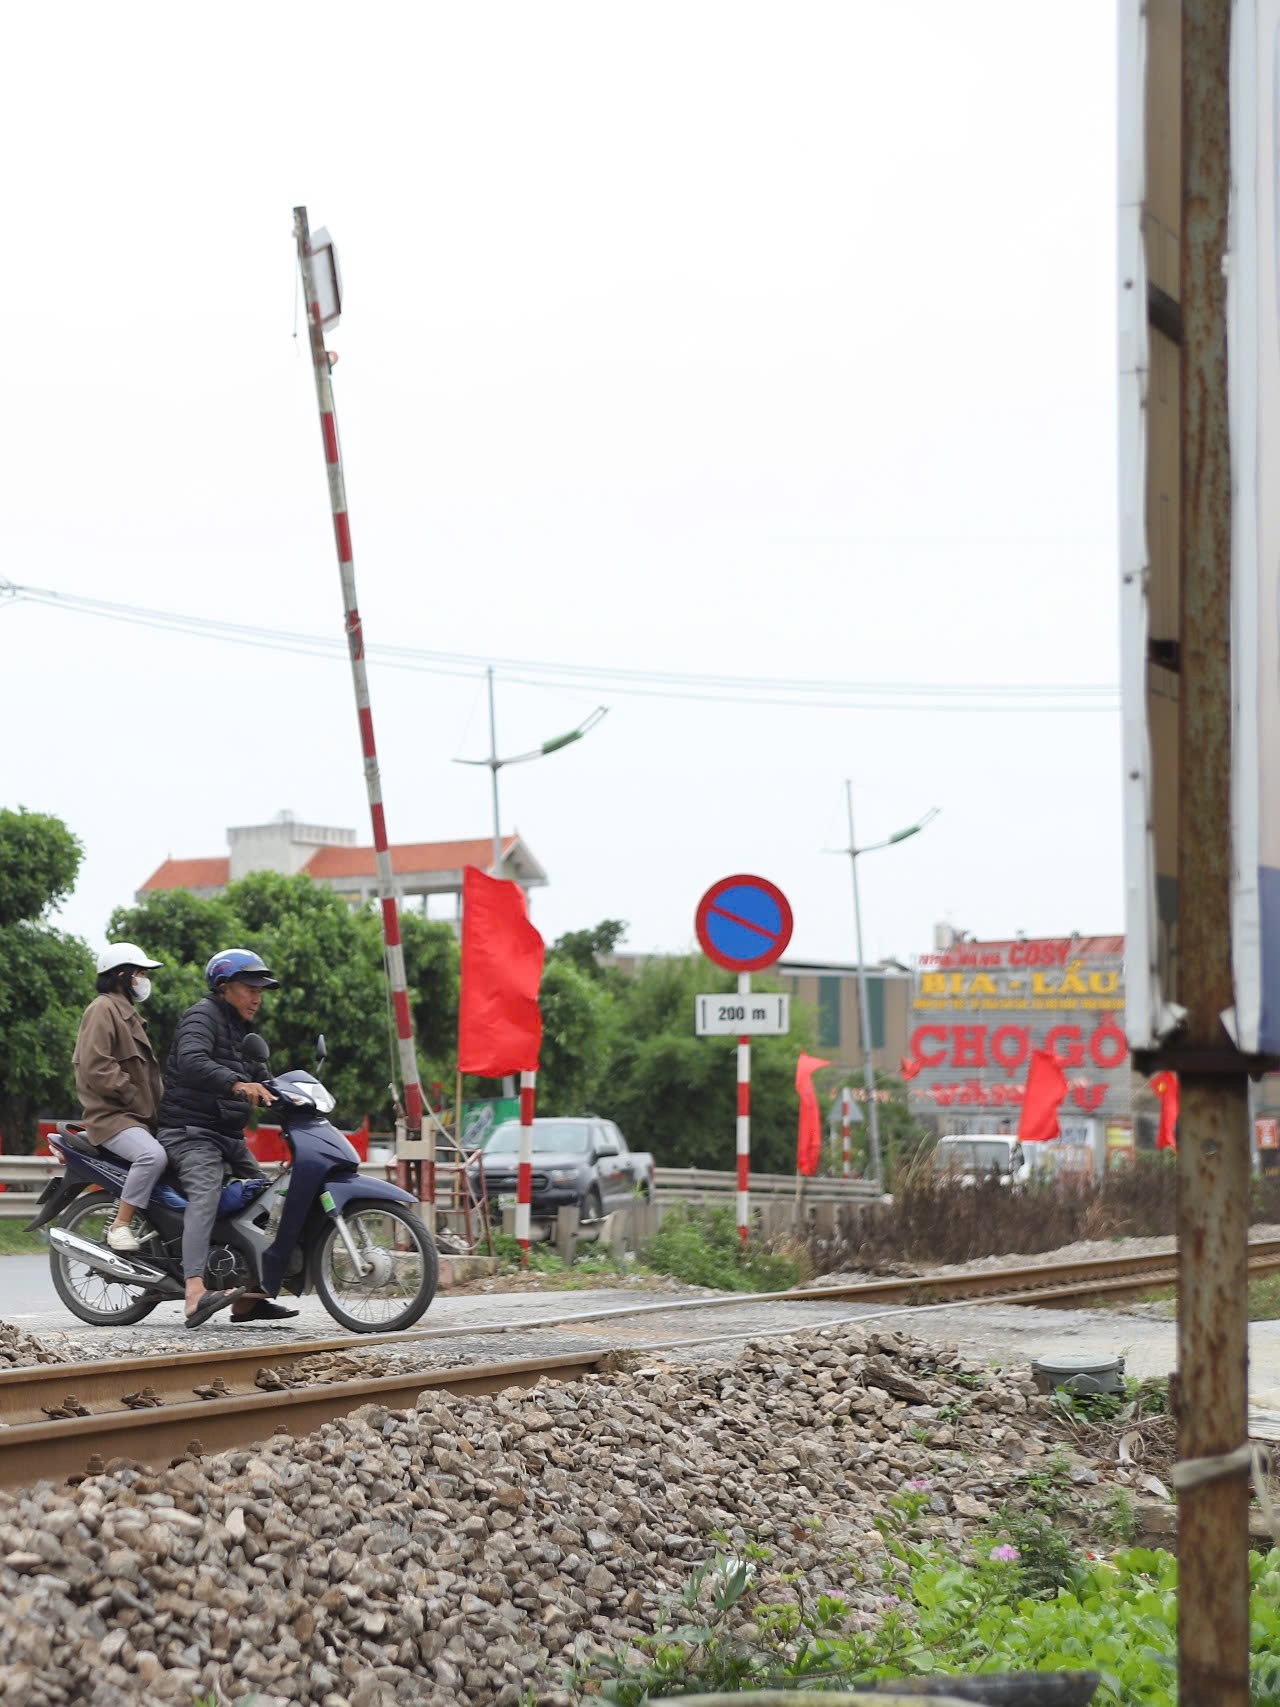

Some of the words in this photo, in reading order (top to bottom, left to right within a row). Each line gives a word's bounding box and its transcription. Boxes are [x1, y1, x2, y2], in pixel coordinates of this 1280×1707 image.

[1007, 943, 1071, 967] COSY
[922, 972, 998, 994] BIA
[718, 1006, 745, 1020] 200
[752, 1008, 766, 1020] m
[910, 1024, 1032, 1077] CHỢ
